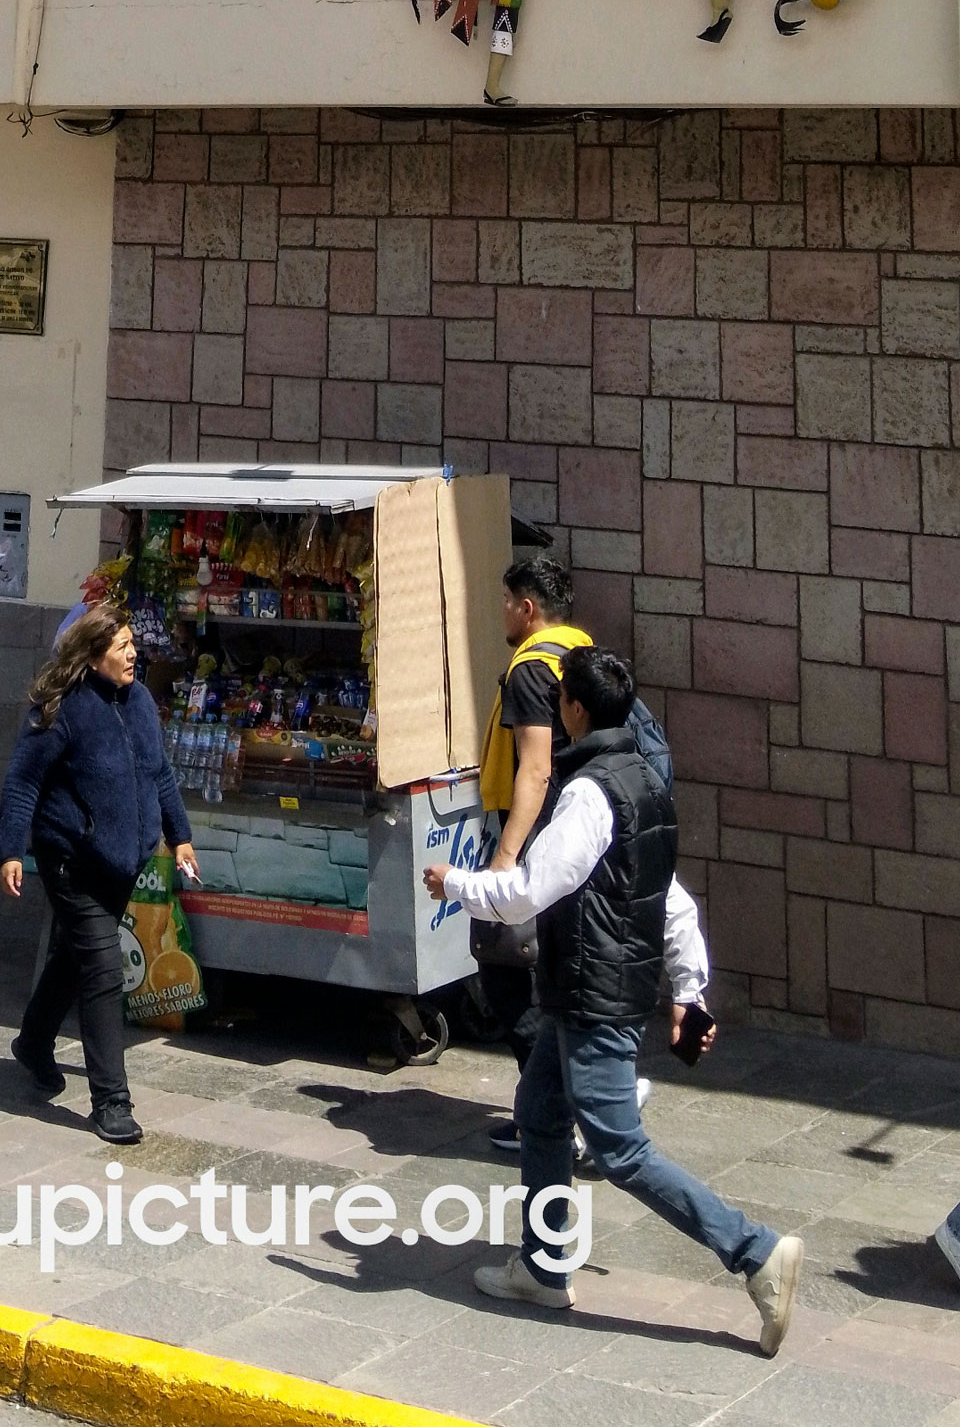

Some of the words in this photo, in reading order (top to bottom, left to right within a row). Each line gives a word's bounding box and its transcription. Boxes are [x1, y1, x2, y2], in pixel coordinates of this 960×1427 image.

[126, 1004, 165, 1022] MEJORES
[165, 993, 206, 1014] SABORES
[127, 989, 161, 1009] MENOS
[162, 982, 193, 1000] FLORO
